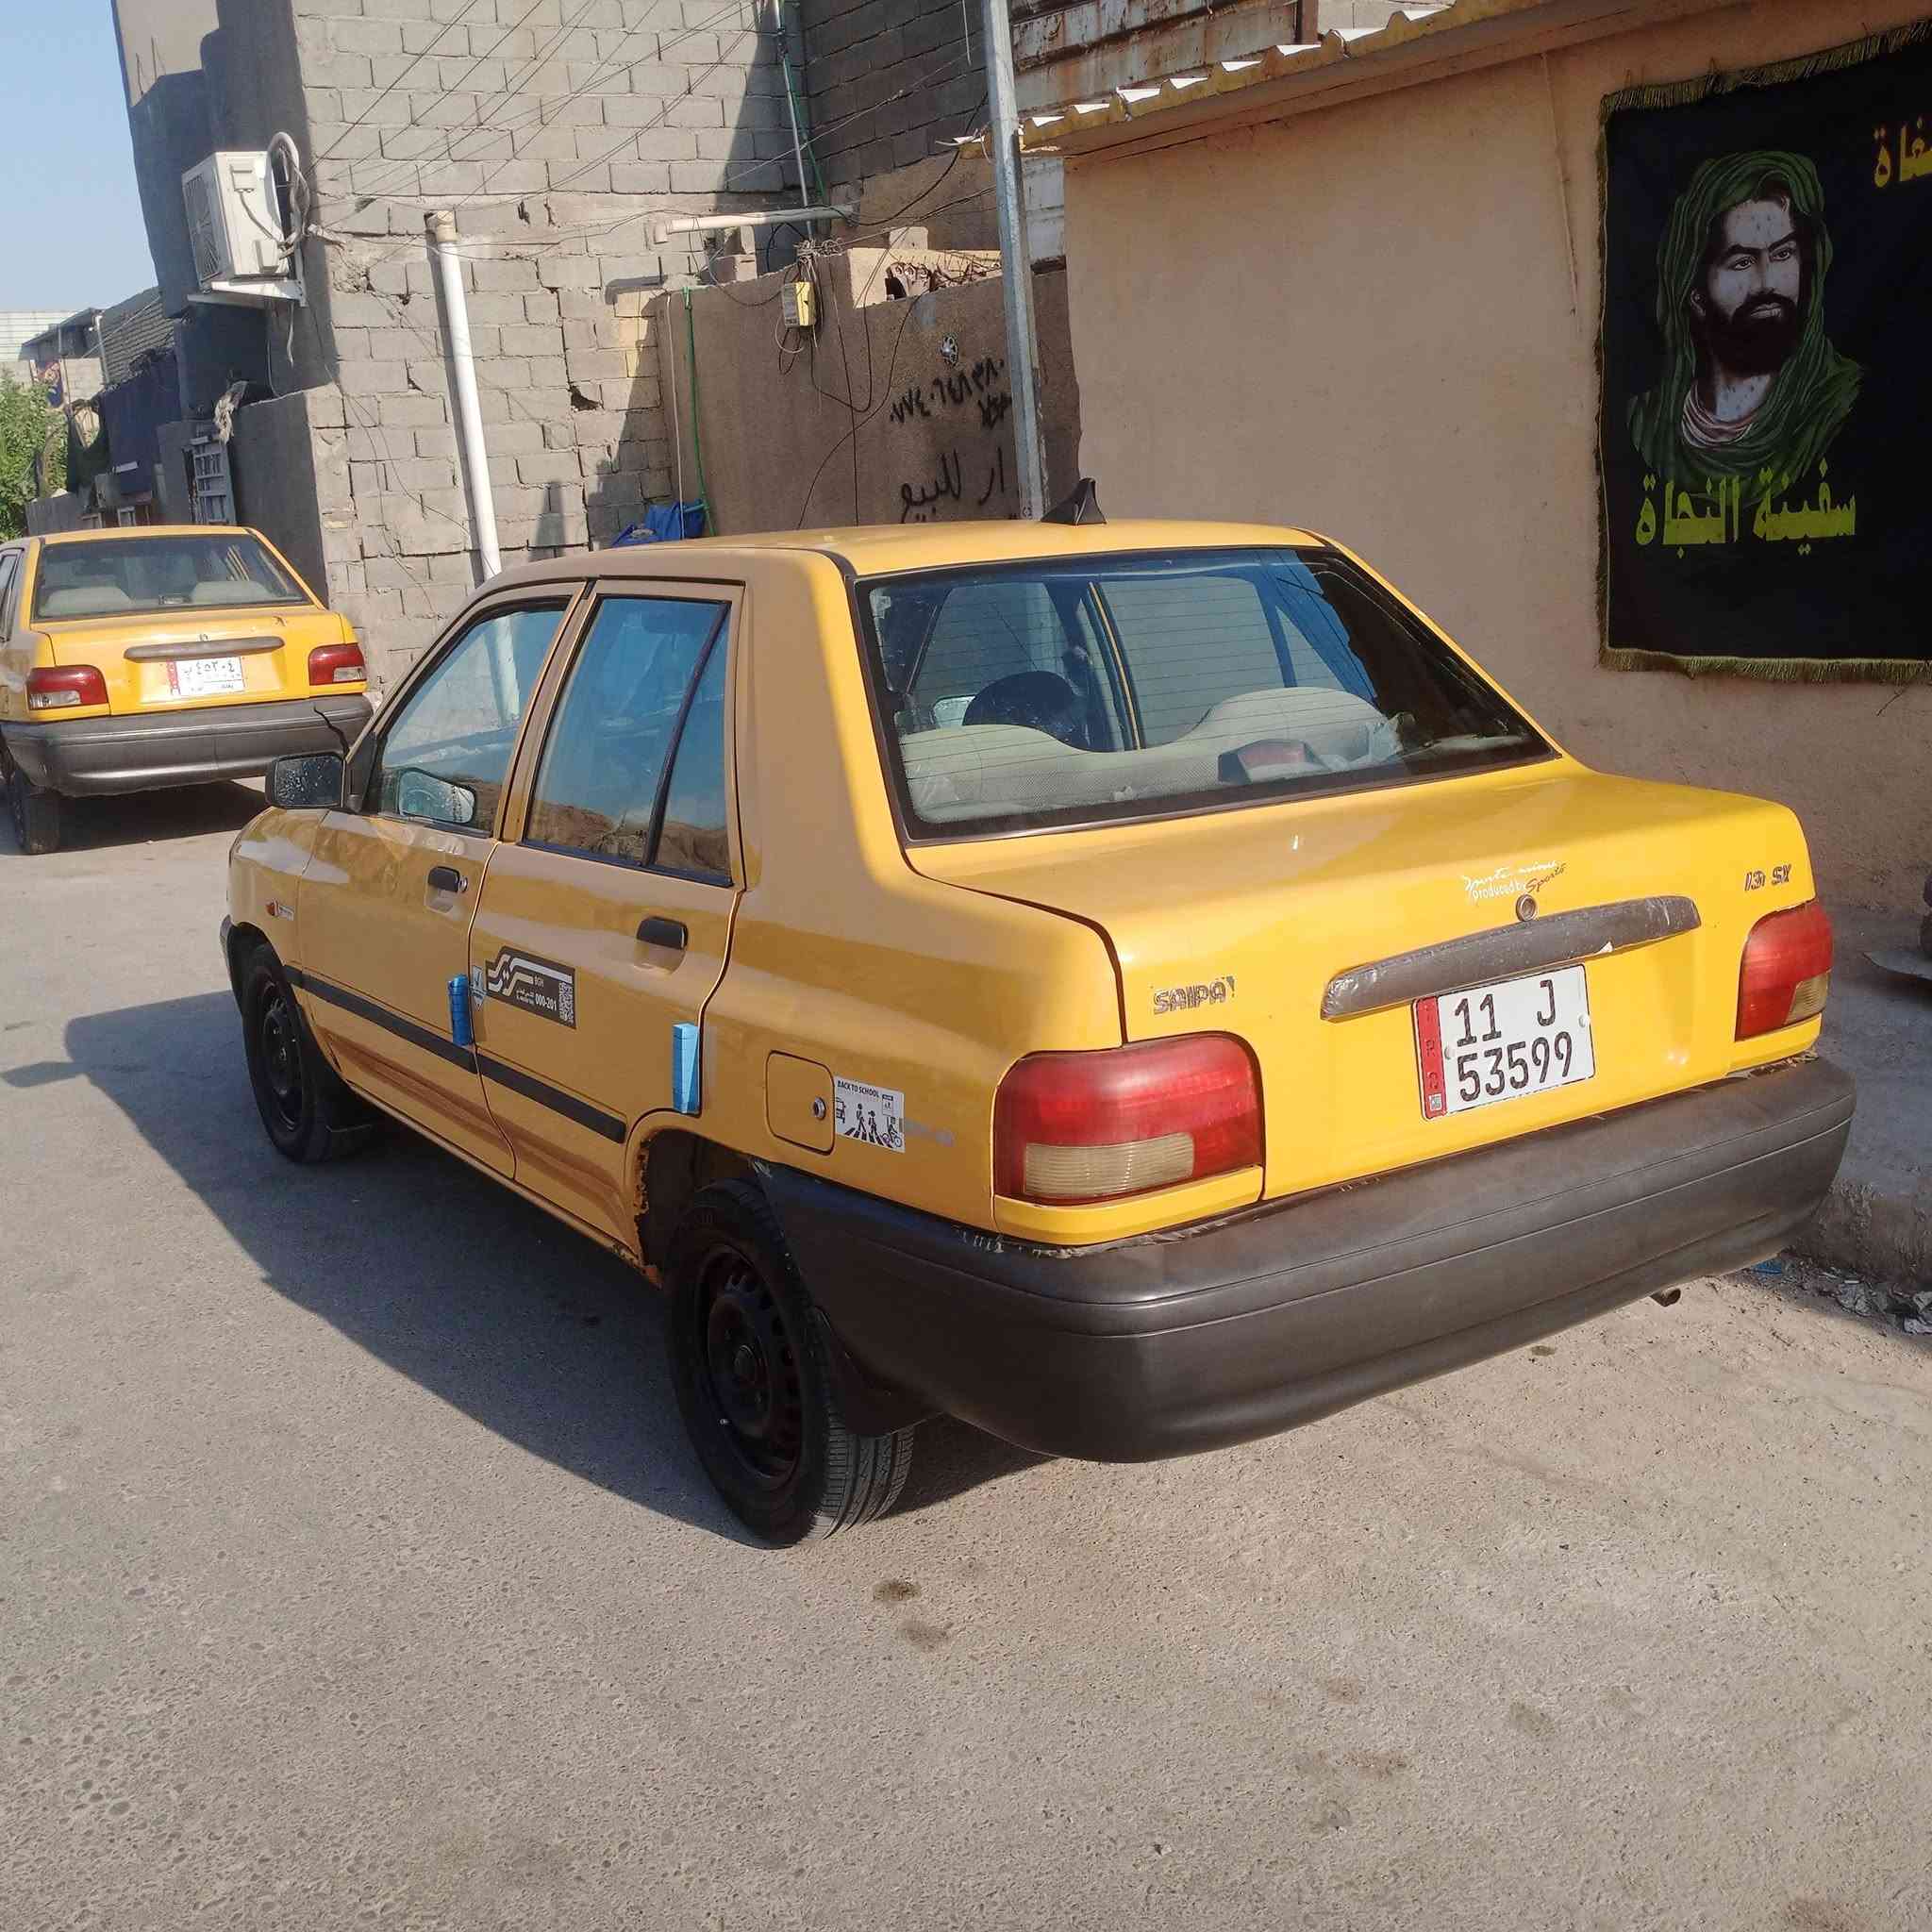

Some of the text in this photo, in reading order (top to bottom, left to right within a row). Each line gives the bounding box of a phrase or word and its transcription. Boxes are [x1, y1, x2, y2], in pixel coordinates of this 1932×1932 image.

[900, 448, 962, 525] للبيع
[1635, 457, 1857, 559] سفينة النجاة
[1152, 980, 1226, 1015] SAIPA
[1454, 978, 1557, 1047] 11 J
[837, 1080, 851, 1091] BACK
[858, 1086, 879, 1098] SCHOOL
[1457, 1030, 1574, 1102] 53599
